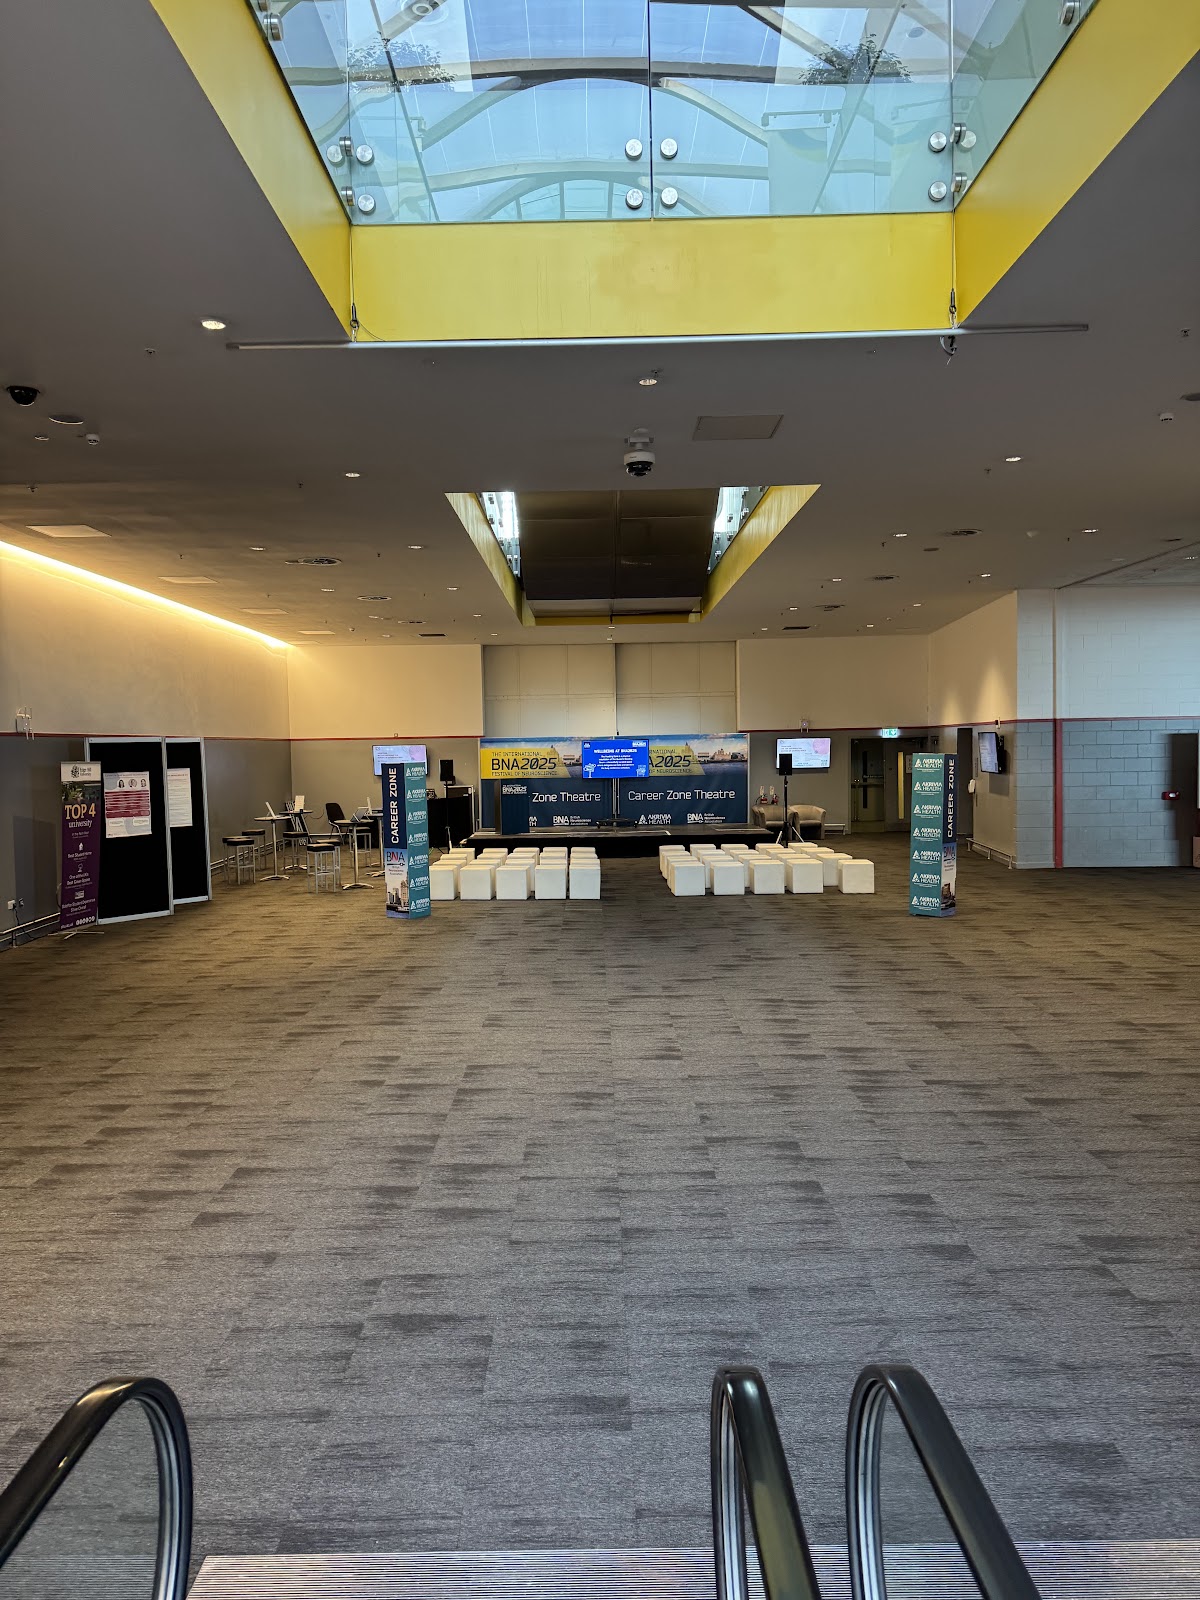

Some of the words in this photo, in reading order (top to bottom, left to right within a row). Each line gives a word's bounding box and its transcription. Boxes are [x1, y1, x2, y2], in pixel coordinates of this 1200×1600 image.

[492, 758, 557, 770] BNA2025
[389, 768, 397, 798] ZONE
[532, 792, 557, 802] Zone
[560, 791, 601, 802] Theatre
[628, 791, 664, 802] Career
[666, 790, 692, 800] Zone
[694, 789, 735, 800] Theatre
[64, 804, 87, 820] TOP
[89, 803, 96, 817] 4
[68, 819, 92, 828] university
[390, 801, 399, 844] CAREER
[387, 851, 405, 863] BNA
